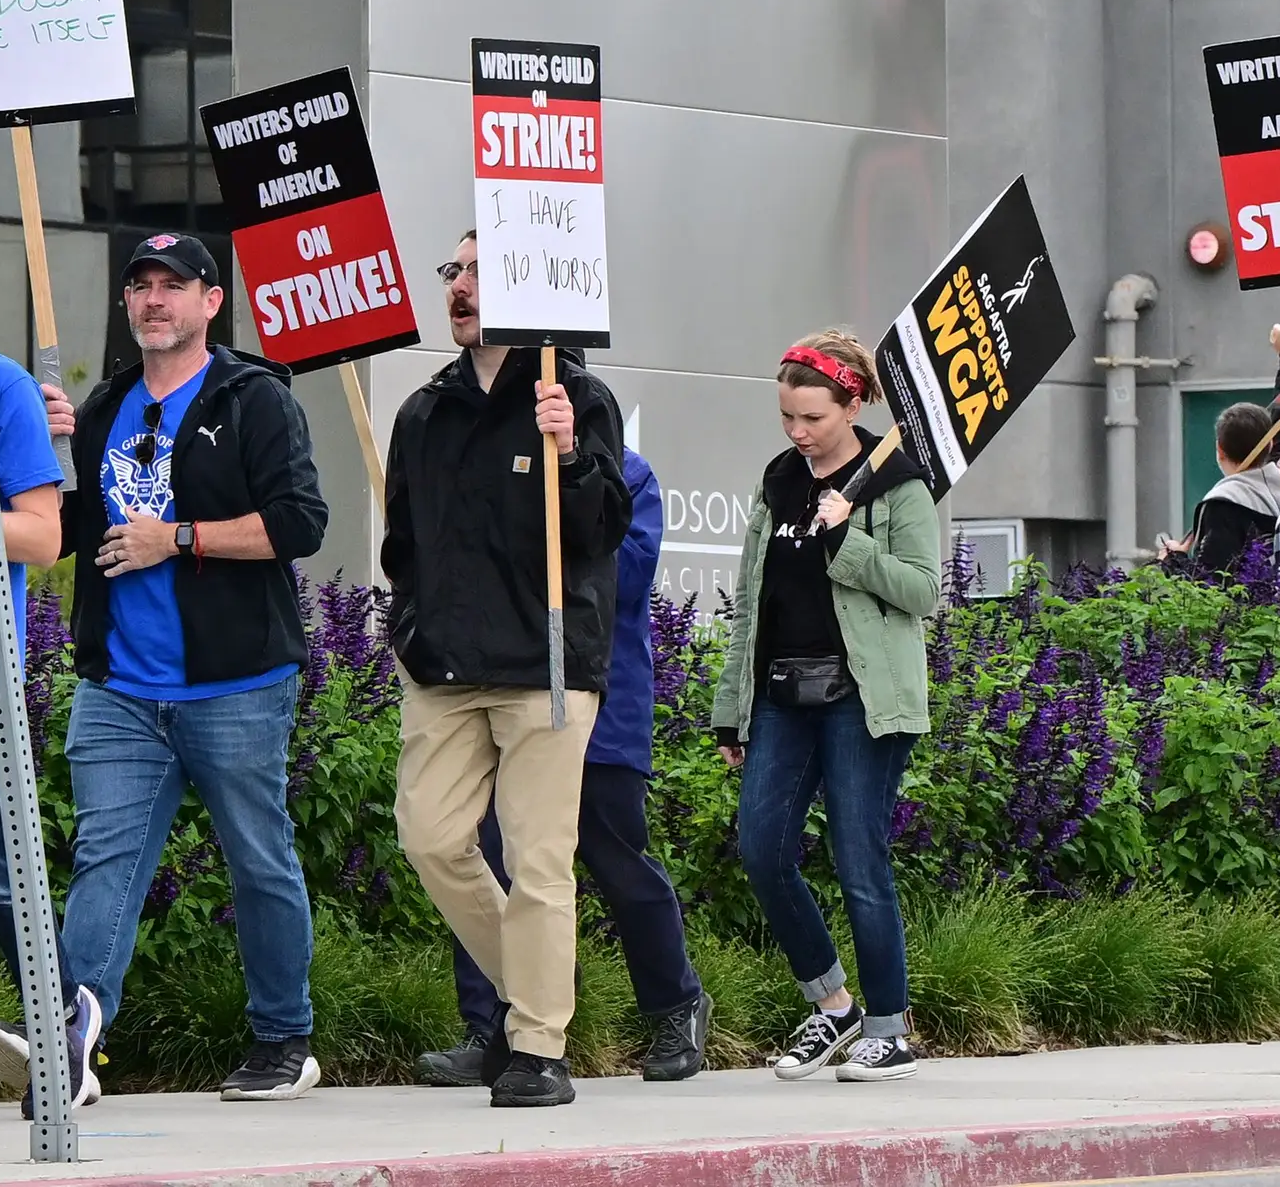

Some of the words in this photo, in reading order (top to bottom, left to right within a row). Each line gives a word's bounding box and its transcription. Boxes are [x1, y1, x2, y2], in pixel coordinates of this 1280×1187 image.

[31, 15, 115, 44] ITSELF
[479, 51, 549, 82] WRITERS
[551, 57, 595, 85] GUILD
[213, 106, 293, 150] WRITERS
[294, 92, 350, 128] GUILD
[532, 89, 547, 108] ON
[278, 142, 298, 165] OF
[481, 111, 597, 173] STRIKE!
[258, 164, 341, 208] AMERICA
[491, 189, 508, 229] I
[529, 190, 578, 234] HAVE
[296, 225, 333, 261] ON
[255, 249, 402, 336] STRIKE!
[503, 249, 530, 291] NO
[543, 249, 602, 300] WORDS
[953, 265, 1009, 412] SUPPORTS
[926, 281, 988, 445] WGA
[904, 325, 916, 354] Acting
[942, 437, 956, 466] Future
[157, 435, 174, 449] OF
[660, 489, 752, 534] DSON
[660, 567, 732, 596] ACIFI
